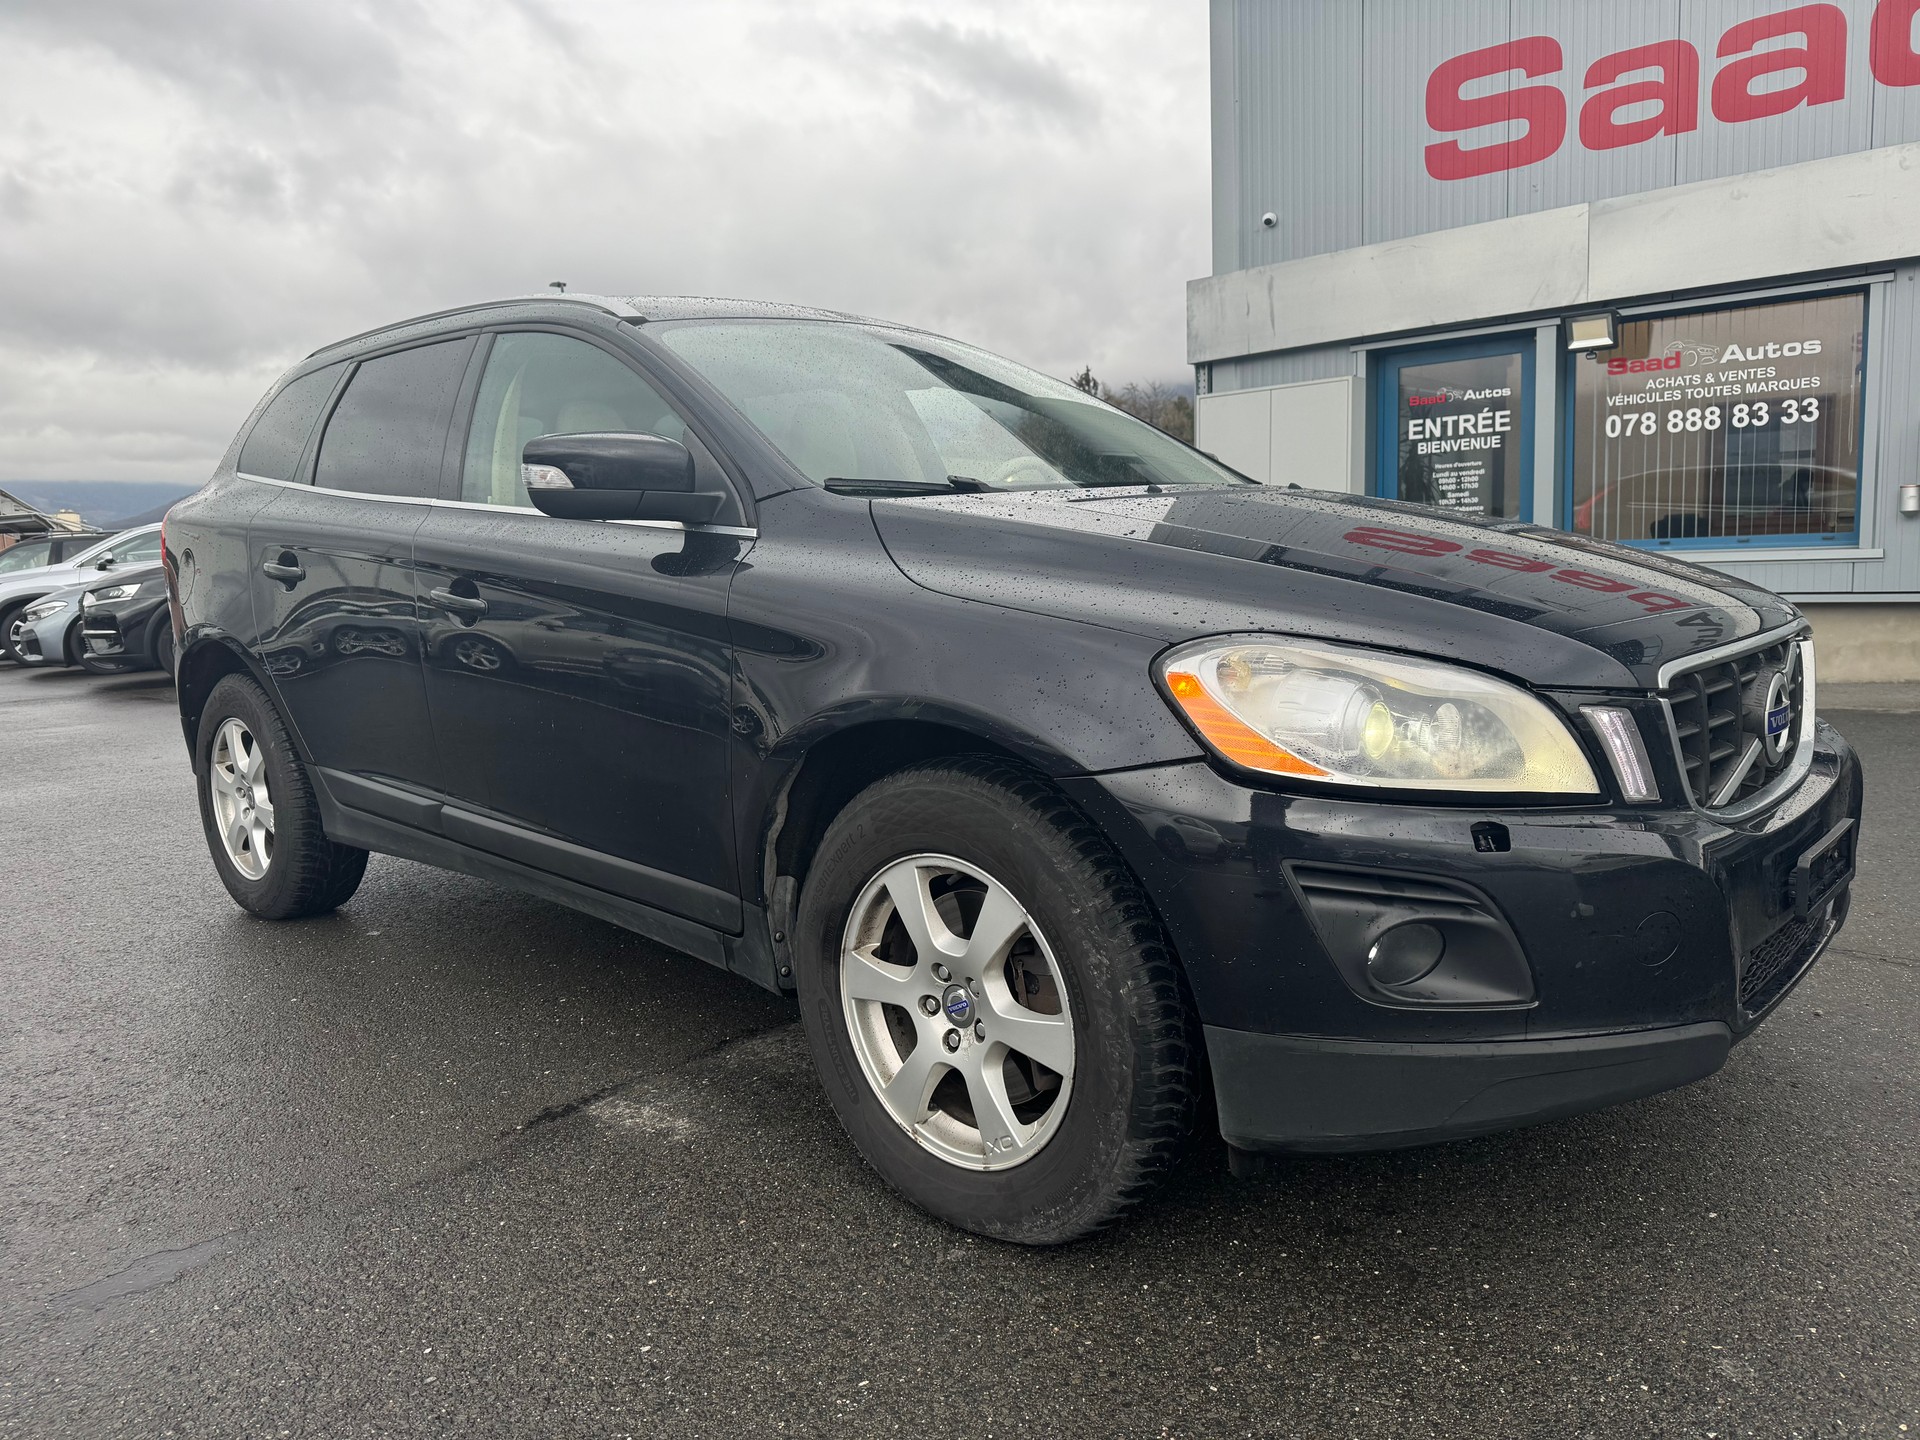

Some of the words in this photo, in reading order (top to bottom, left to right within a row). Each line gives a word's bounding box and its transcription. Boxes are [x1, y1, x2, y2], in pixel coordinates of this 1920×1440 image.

[1607, 351, 1682, 376] Saad
[1719, 339, 1823, 364] Autos
[1646, 374, 1701, 390] ACHATS
[1705, 372, 1715, 384] &
[1718, 366, 1776, 382] VENTES
[1409, 393, 1446, 406] Saad
[1463, 387, 1511, 401] Autos
[1606, 389, 1682, 407] VÉHICULES
[1685, 384, 1742, 400] TOUTES
[1745, 376, 1821, 394] MARQUES
[1408, 407, 1511, 440] ENTRÉE
[1605, 411, 1657, 438] 078
[1667, 405, 1722, 434] 888
[1732, 402, 1770, 428] 83
[1780, 397, 1820, 424] 33
[1417, 435, 1502, 455] BIENVENUE
[1458, 468, 1485, 476] vendredi
[1770, 711, 1790, 728] VOL
[856, 823, 868, 840] 2
[986, 1135, 1013, 1156] XC
